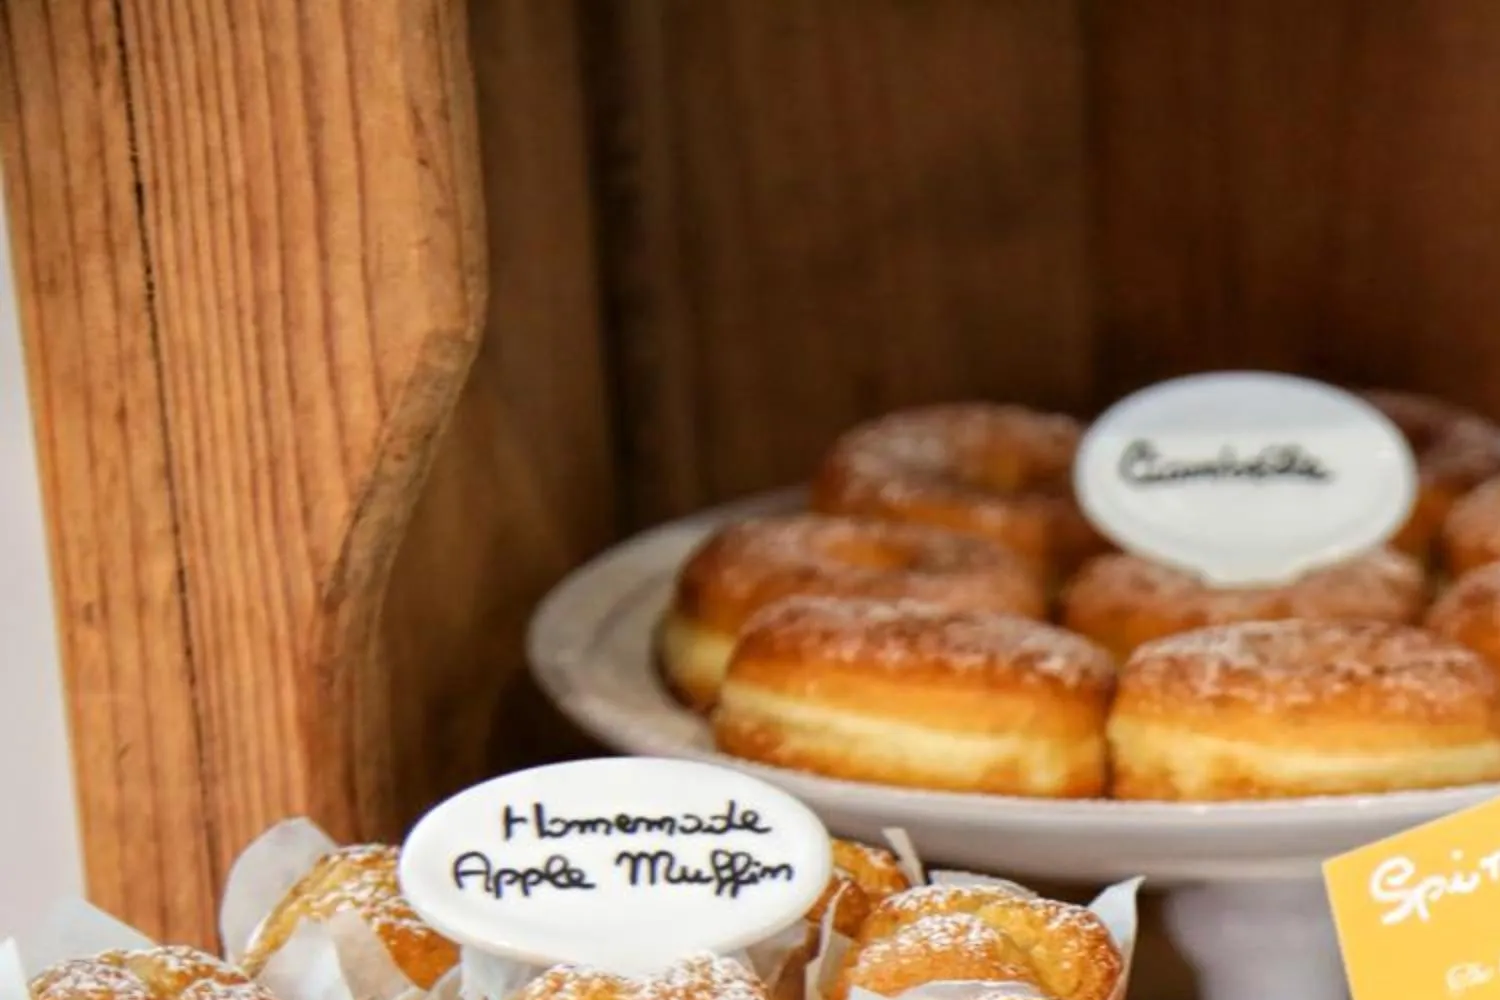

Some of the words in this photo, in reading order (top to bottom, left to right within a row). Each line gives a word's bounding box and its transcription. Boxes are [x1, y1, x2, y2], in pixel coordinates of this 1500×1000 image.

[502, 800, 771, 841] Homemade
[452, 851, 597, 899] Apple
[613, 849, 794, 899] Muffin
